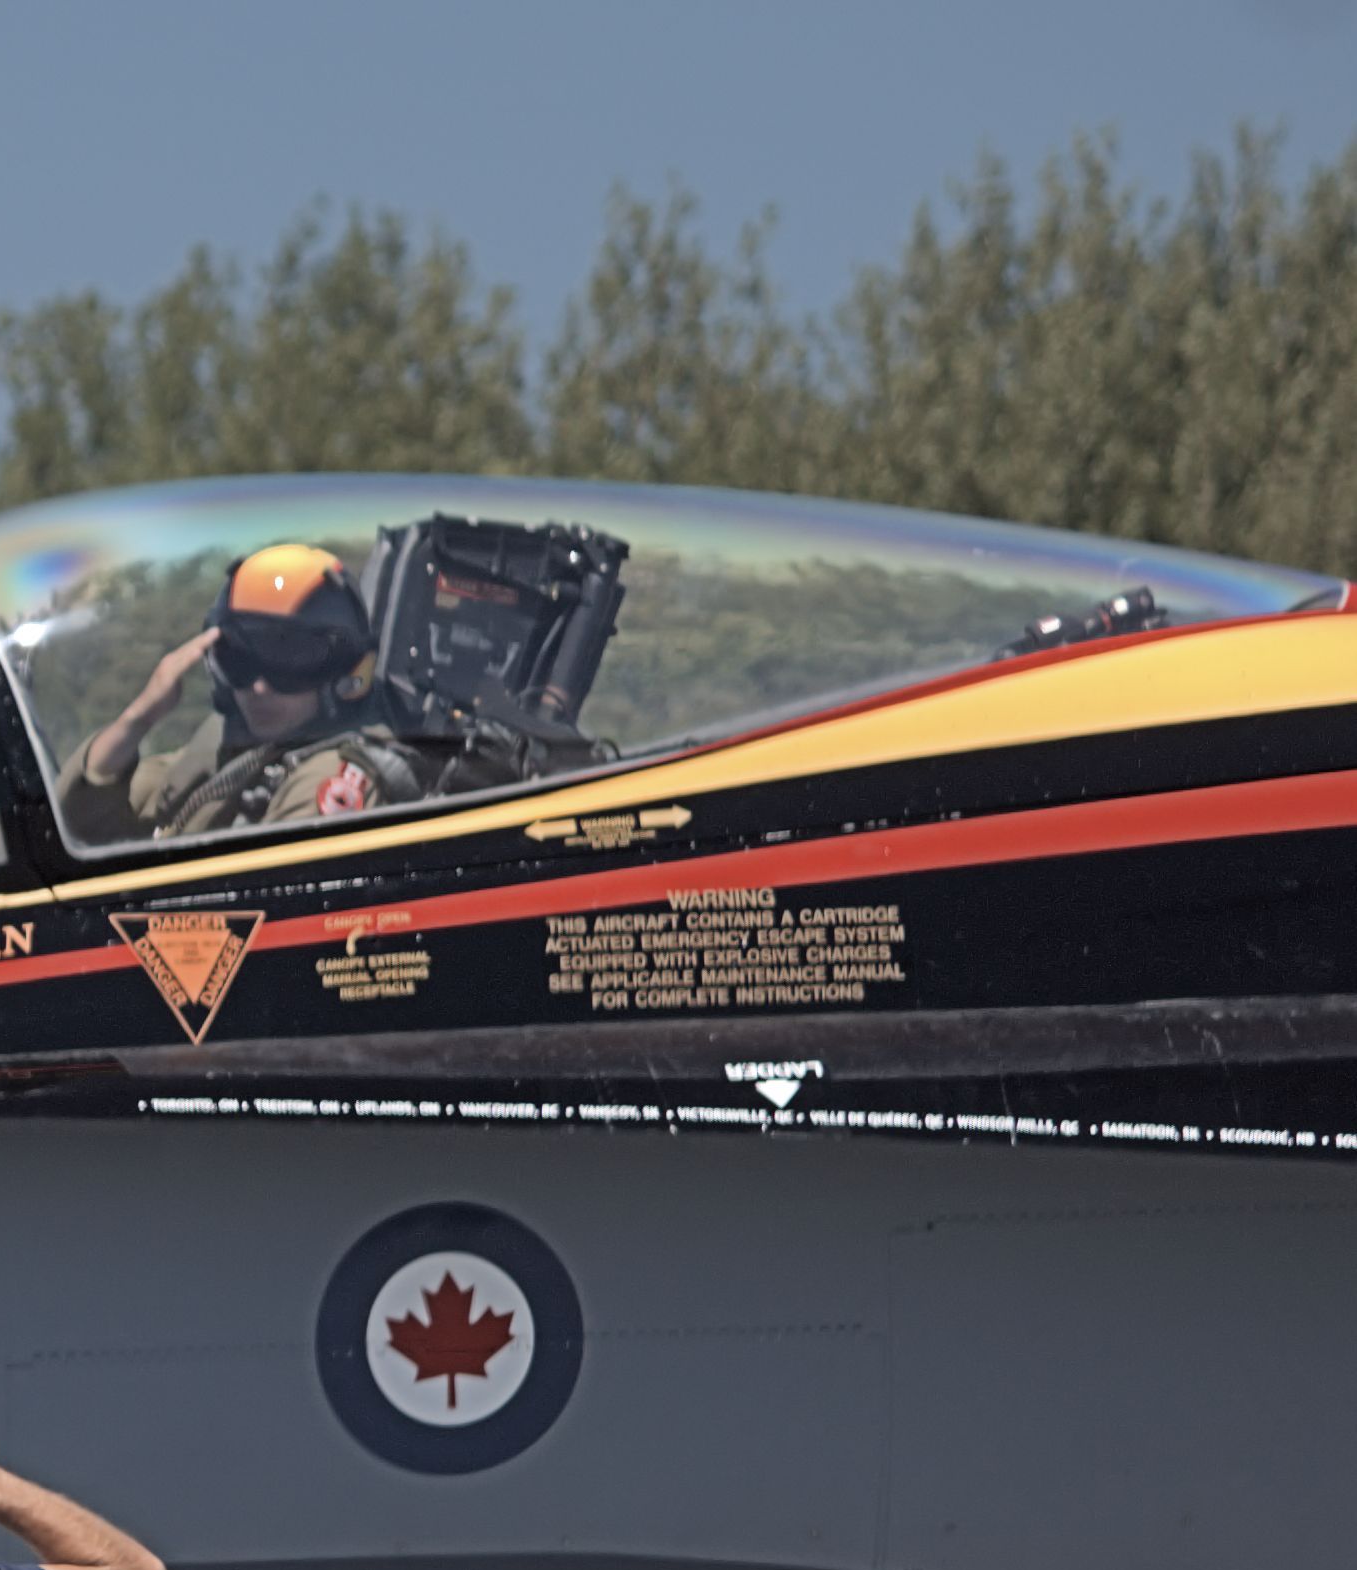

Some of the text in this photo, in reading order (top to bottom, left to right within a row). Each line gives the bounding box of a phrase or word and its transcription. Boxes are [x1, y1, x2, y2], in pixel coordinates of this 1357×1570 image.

[666, 887, 775, 911] WARNING
[148, 914, 226, 931] DANGER
[546, 905, 899, 934] THIS AIRCRAFT CONTAINS A CARTRIDGE
[545, 925, 905, 954] ACTUATED EMERGENCY ESCAPE SYSTEM
[133, 936, 187, 1007] DANGER
[200, 934, 244, 1009] DANGER
[560, 945, 892, 971] EQUIPPED WITH EXPLOSIVE CHARGES
[548, 963, 906, 994] SEE APPLICABLE MAINTENANCE MANUAL
[592, 982, 865, 1010] FOR COMPLETE INSTRUCTIONS
[724, 1060, 823, 1081] LADDER
